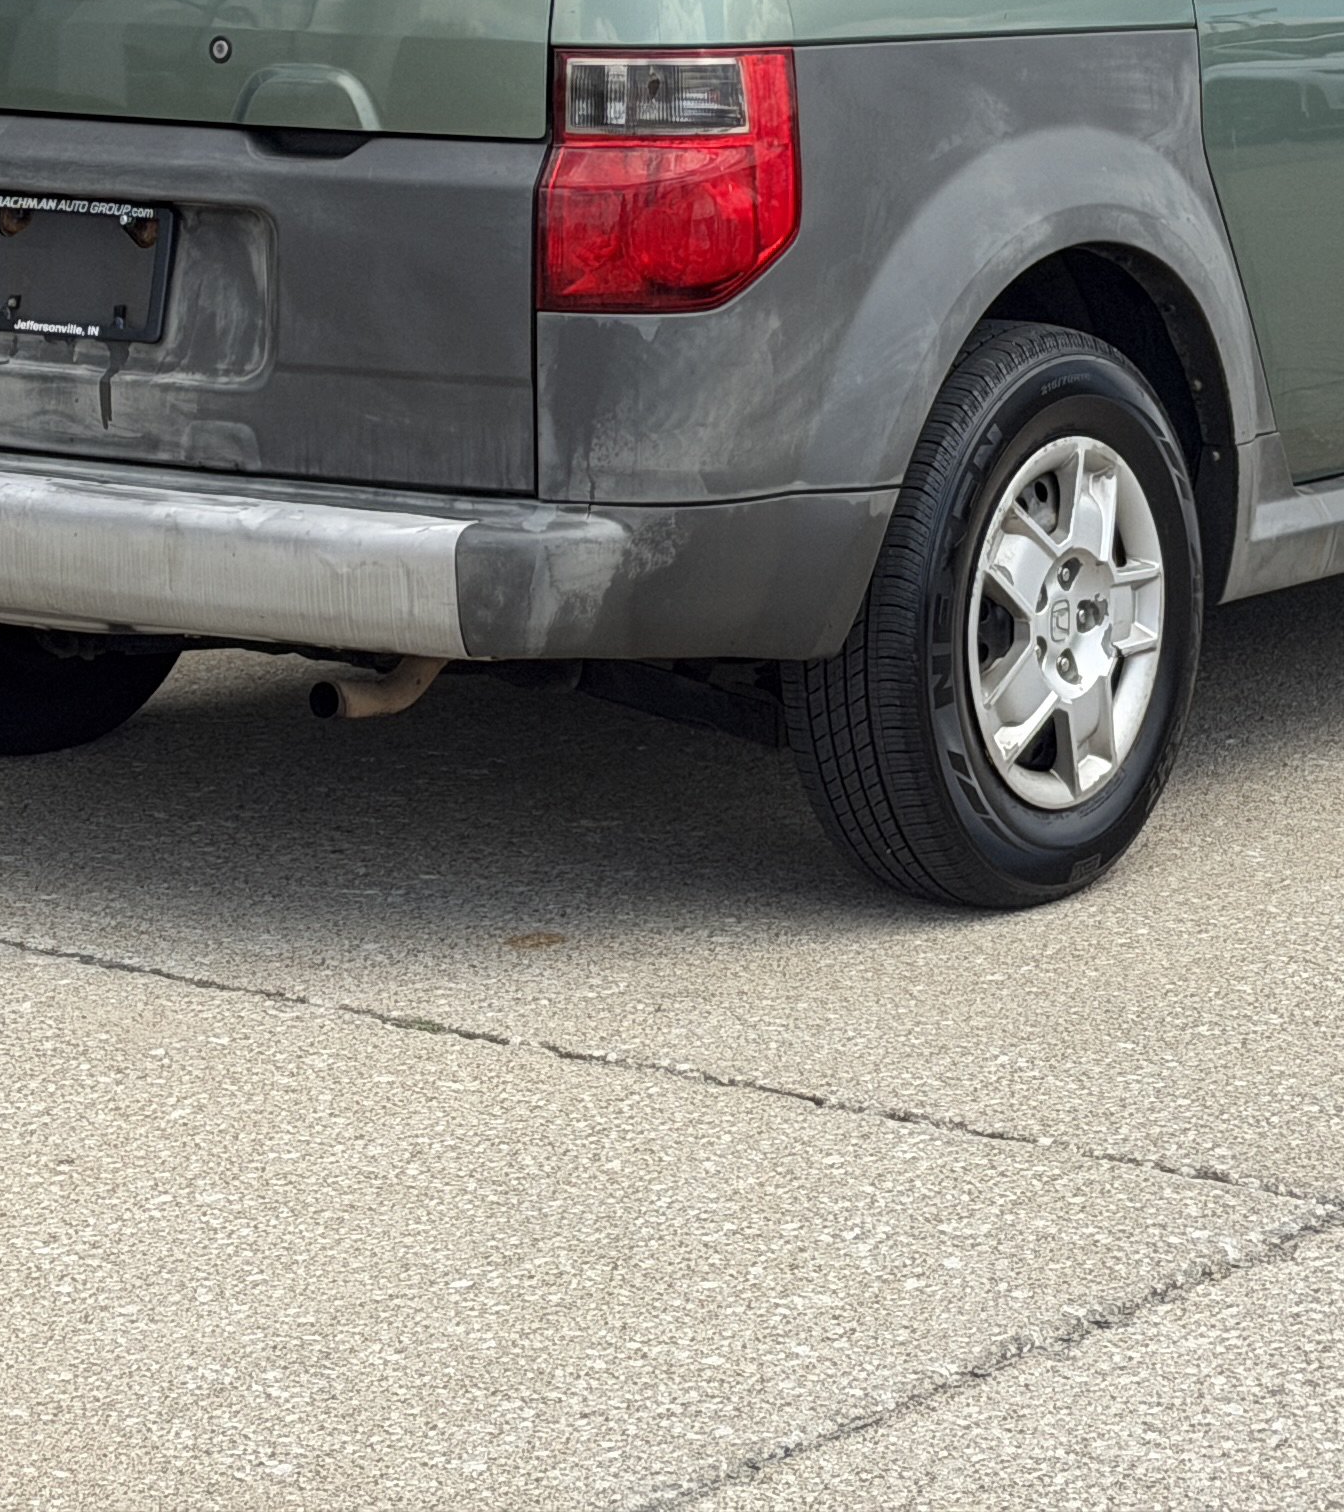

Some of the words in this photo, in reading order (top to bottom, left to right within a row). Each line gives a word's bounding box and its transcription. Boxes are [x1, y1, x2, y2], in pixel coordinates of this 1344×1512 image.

[57, 200, 88, 213] AUTO
[89, 201, 154, 219] GROUP.com
[14, 319, 85, 336] Jeffersonville,
[87, 325, 100, 337] IN
